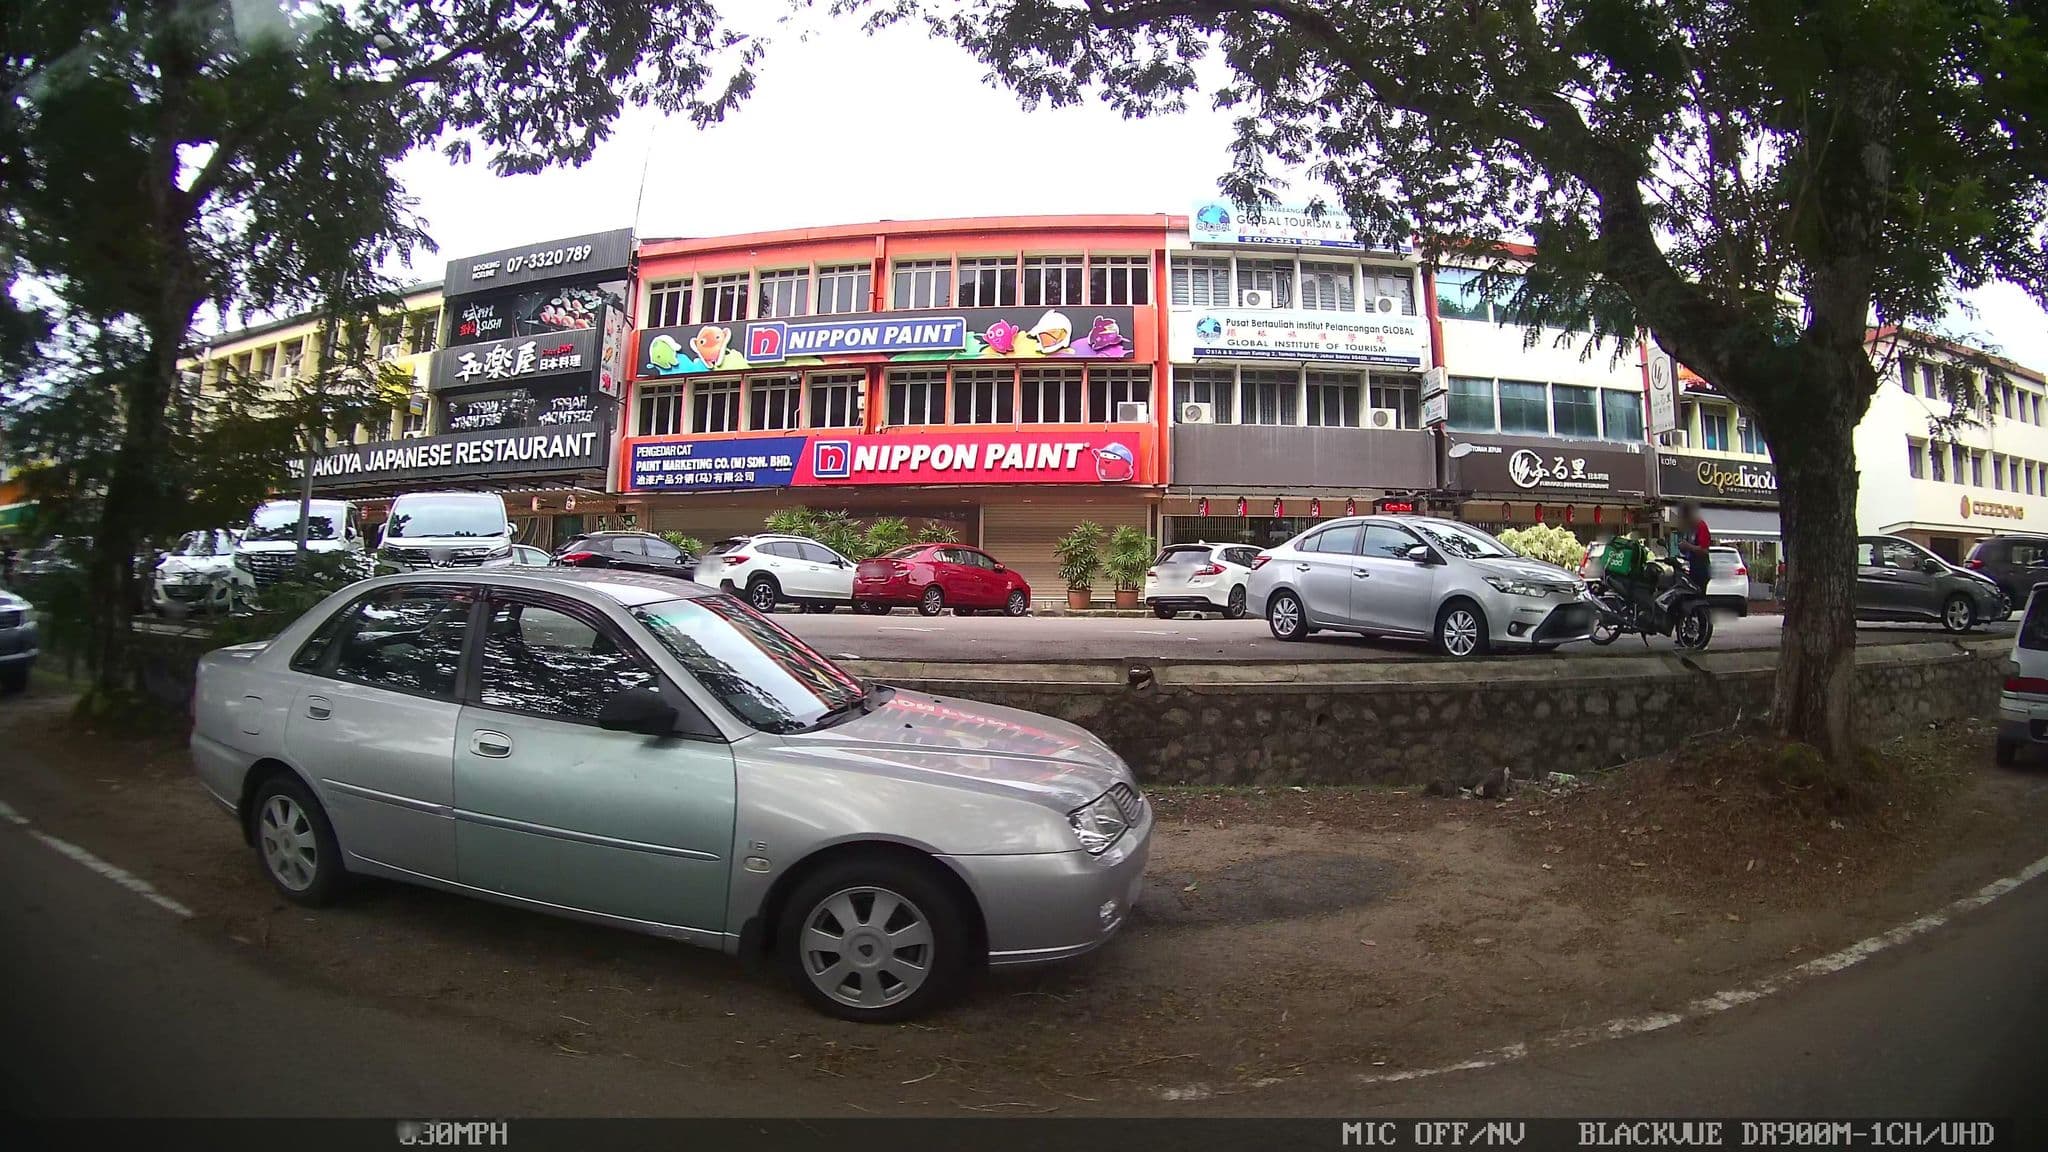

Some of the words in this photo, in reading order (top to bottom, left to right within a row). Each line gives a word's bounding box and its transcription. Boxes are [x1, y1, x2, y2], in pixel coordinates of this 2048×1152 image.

[1237, 215, 1281, 226] GLOBAL
[1285, 217, 1332, 228] TOURISM
[1335, 221, 1342, 229] &
[506, 249, 563, 273] 07-3320
[566, 244, 592, 263] 789
[788, 326, 879, 350] NIPPON
[883, 323, 957, 346] PAINT
[1226, 318, 1249, 327] Pusat
[1251, 319, 1295, 329] Bertauliah
[1325, 322, 1380, 334] Pelancongan
[1382, 325, 1414, 336] GLOBAL
[1227, 339, 1268, 347] GLOBAL
[1275, 341, 1320, 349] INSTITUTE
[1345, 344, 1387, 353] TOURISM
[539, 354, 582, 371] 日本料理
[365, 442, 452, 472] JAPANESE
[456, 432, 597, 466] RESTAURANT
[636, 445, 676, 458] PENGEDAR
[676, 444, 693, 456] CAT
[854, 443, 979, 471] NIPPON
[984, 442, 1084, 470] PAINT
[636, 459, 662, 472] PAINT
[662, 458, 713, 471] MARKETING
[746, 456, 768, 469] SDN.
[770, 455, 793, 468] BHD.
[1530, 456, 1587, 481] ふる里
[1697, 461, 1778, 494] Cheeliciou
